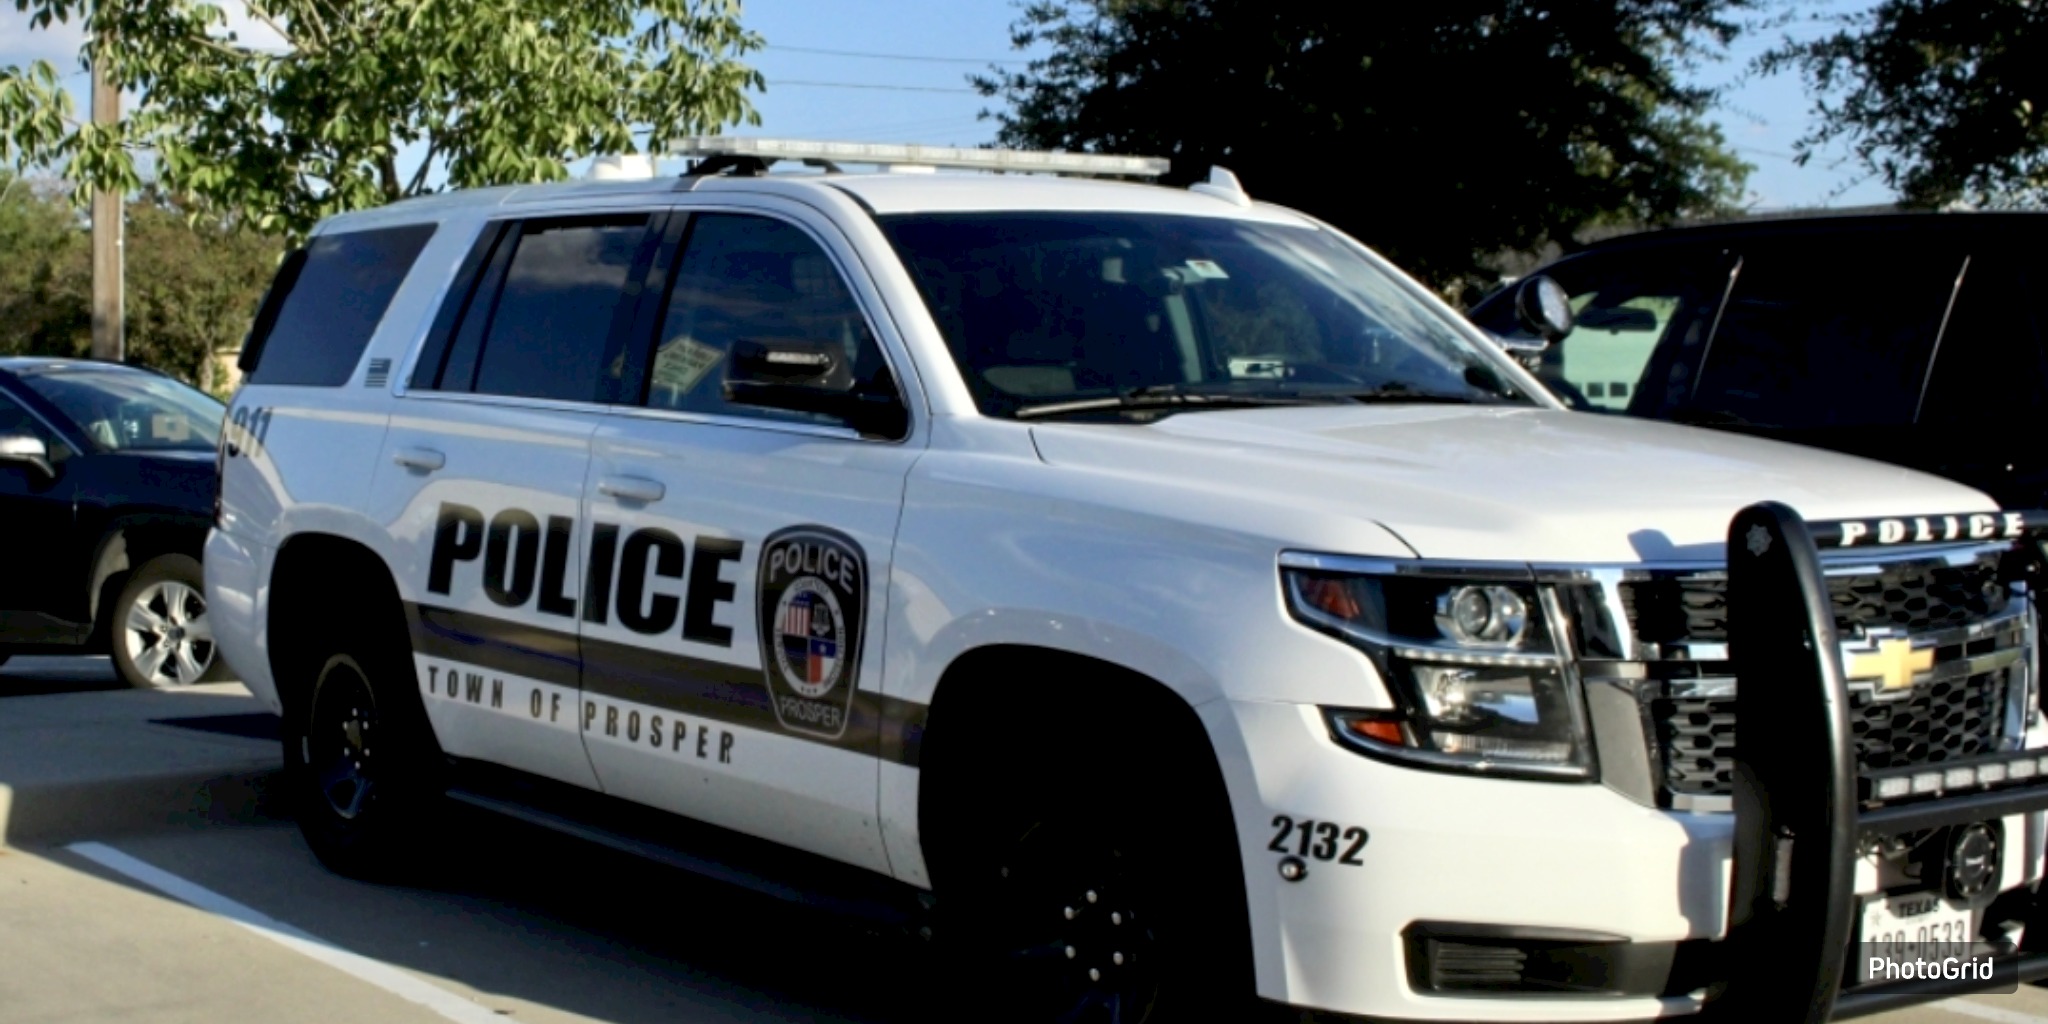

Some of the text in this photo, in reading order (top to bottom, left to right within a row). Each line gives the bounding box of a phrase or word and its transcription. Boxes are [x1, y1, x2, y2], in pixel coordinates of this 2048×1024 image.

[1839, 512, 2025, 547] POLICE
[427, 501, 744, 648] POLICE
[770, 544, 853, 593] POLICE
[428, 665, 735, 764] TOWN OF PROSPER
[781, 697, 840, 727] PROSPER
[1267, 813, 1369, 867] 2132
[1900, 897, 1941, 917] TEXAS
